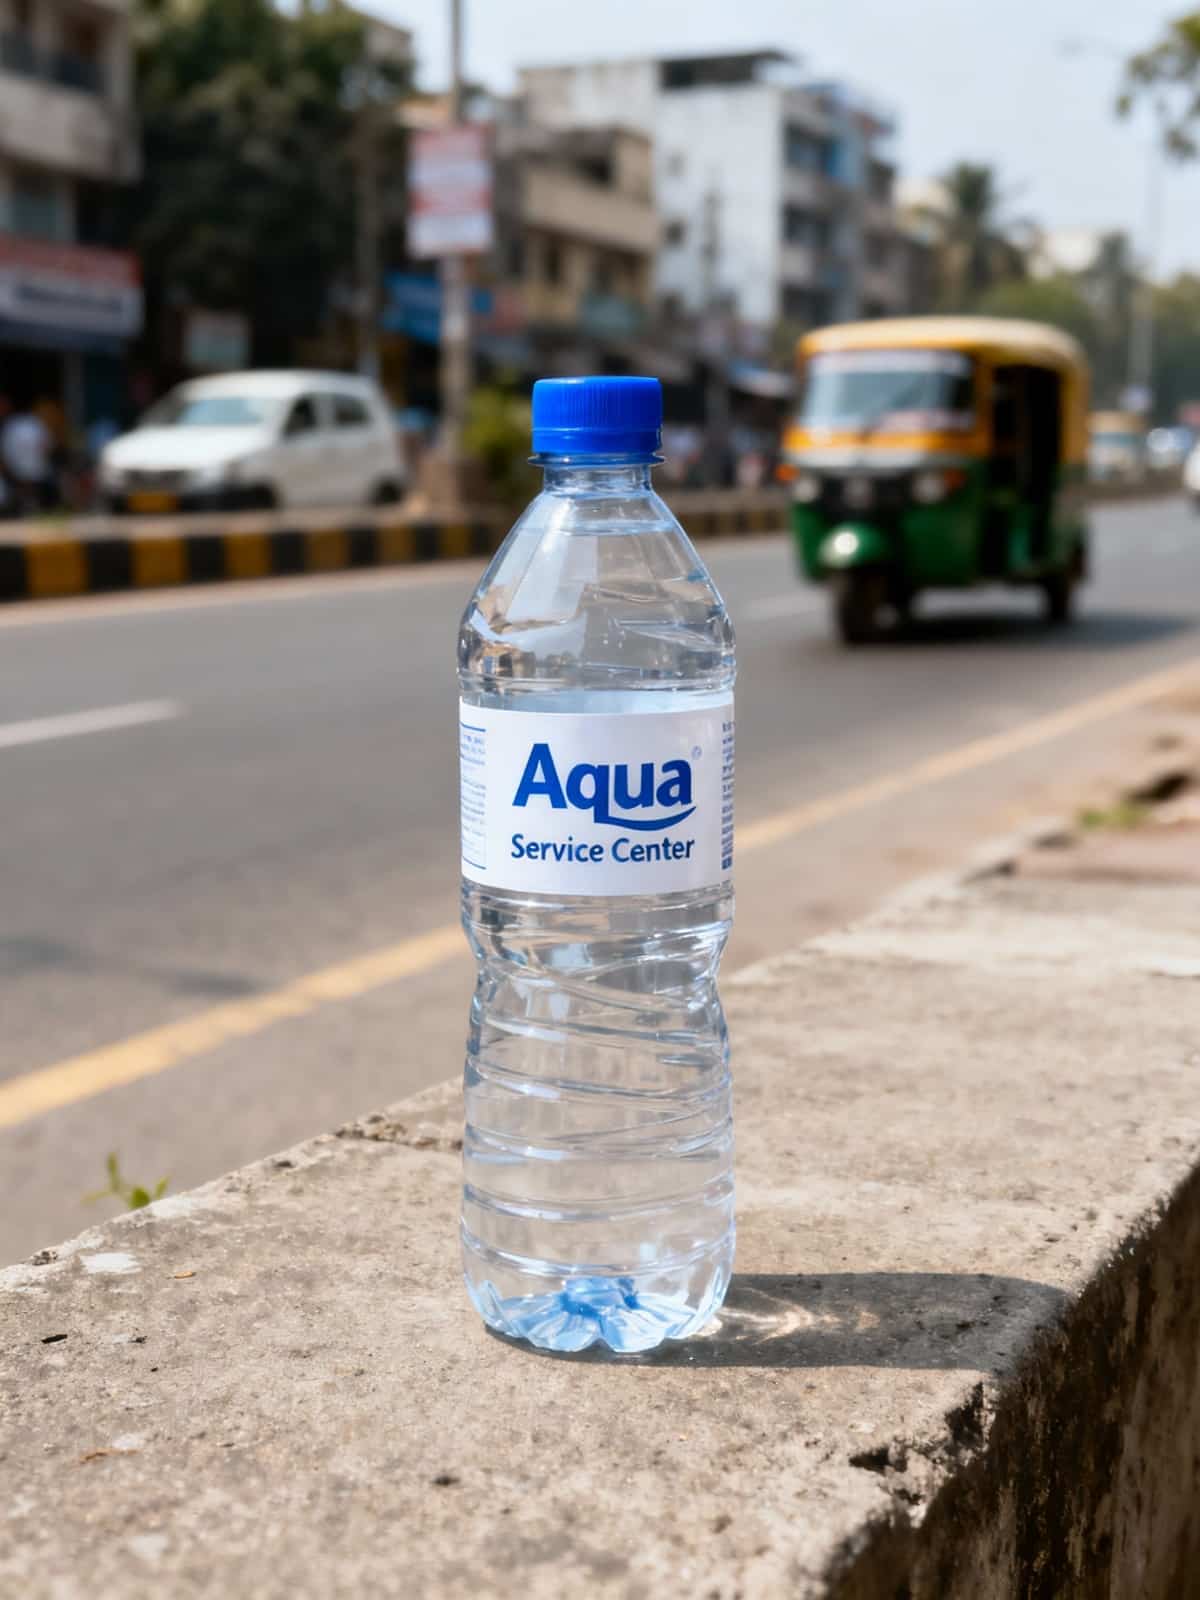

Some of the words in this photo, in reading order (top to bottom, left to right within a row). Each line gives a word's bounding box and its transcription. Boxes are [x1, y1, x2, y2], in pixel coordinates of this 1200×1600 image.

[512, 743, 695, 830] Aqua
[511, 834, 605, 863] Service
[611, 837, 695, 863] Center
